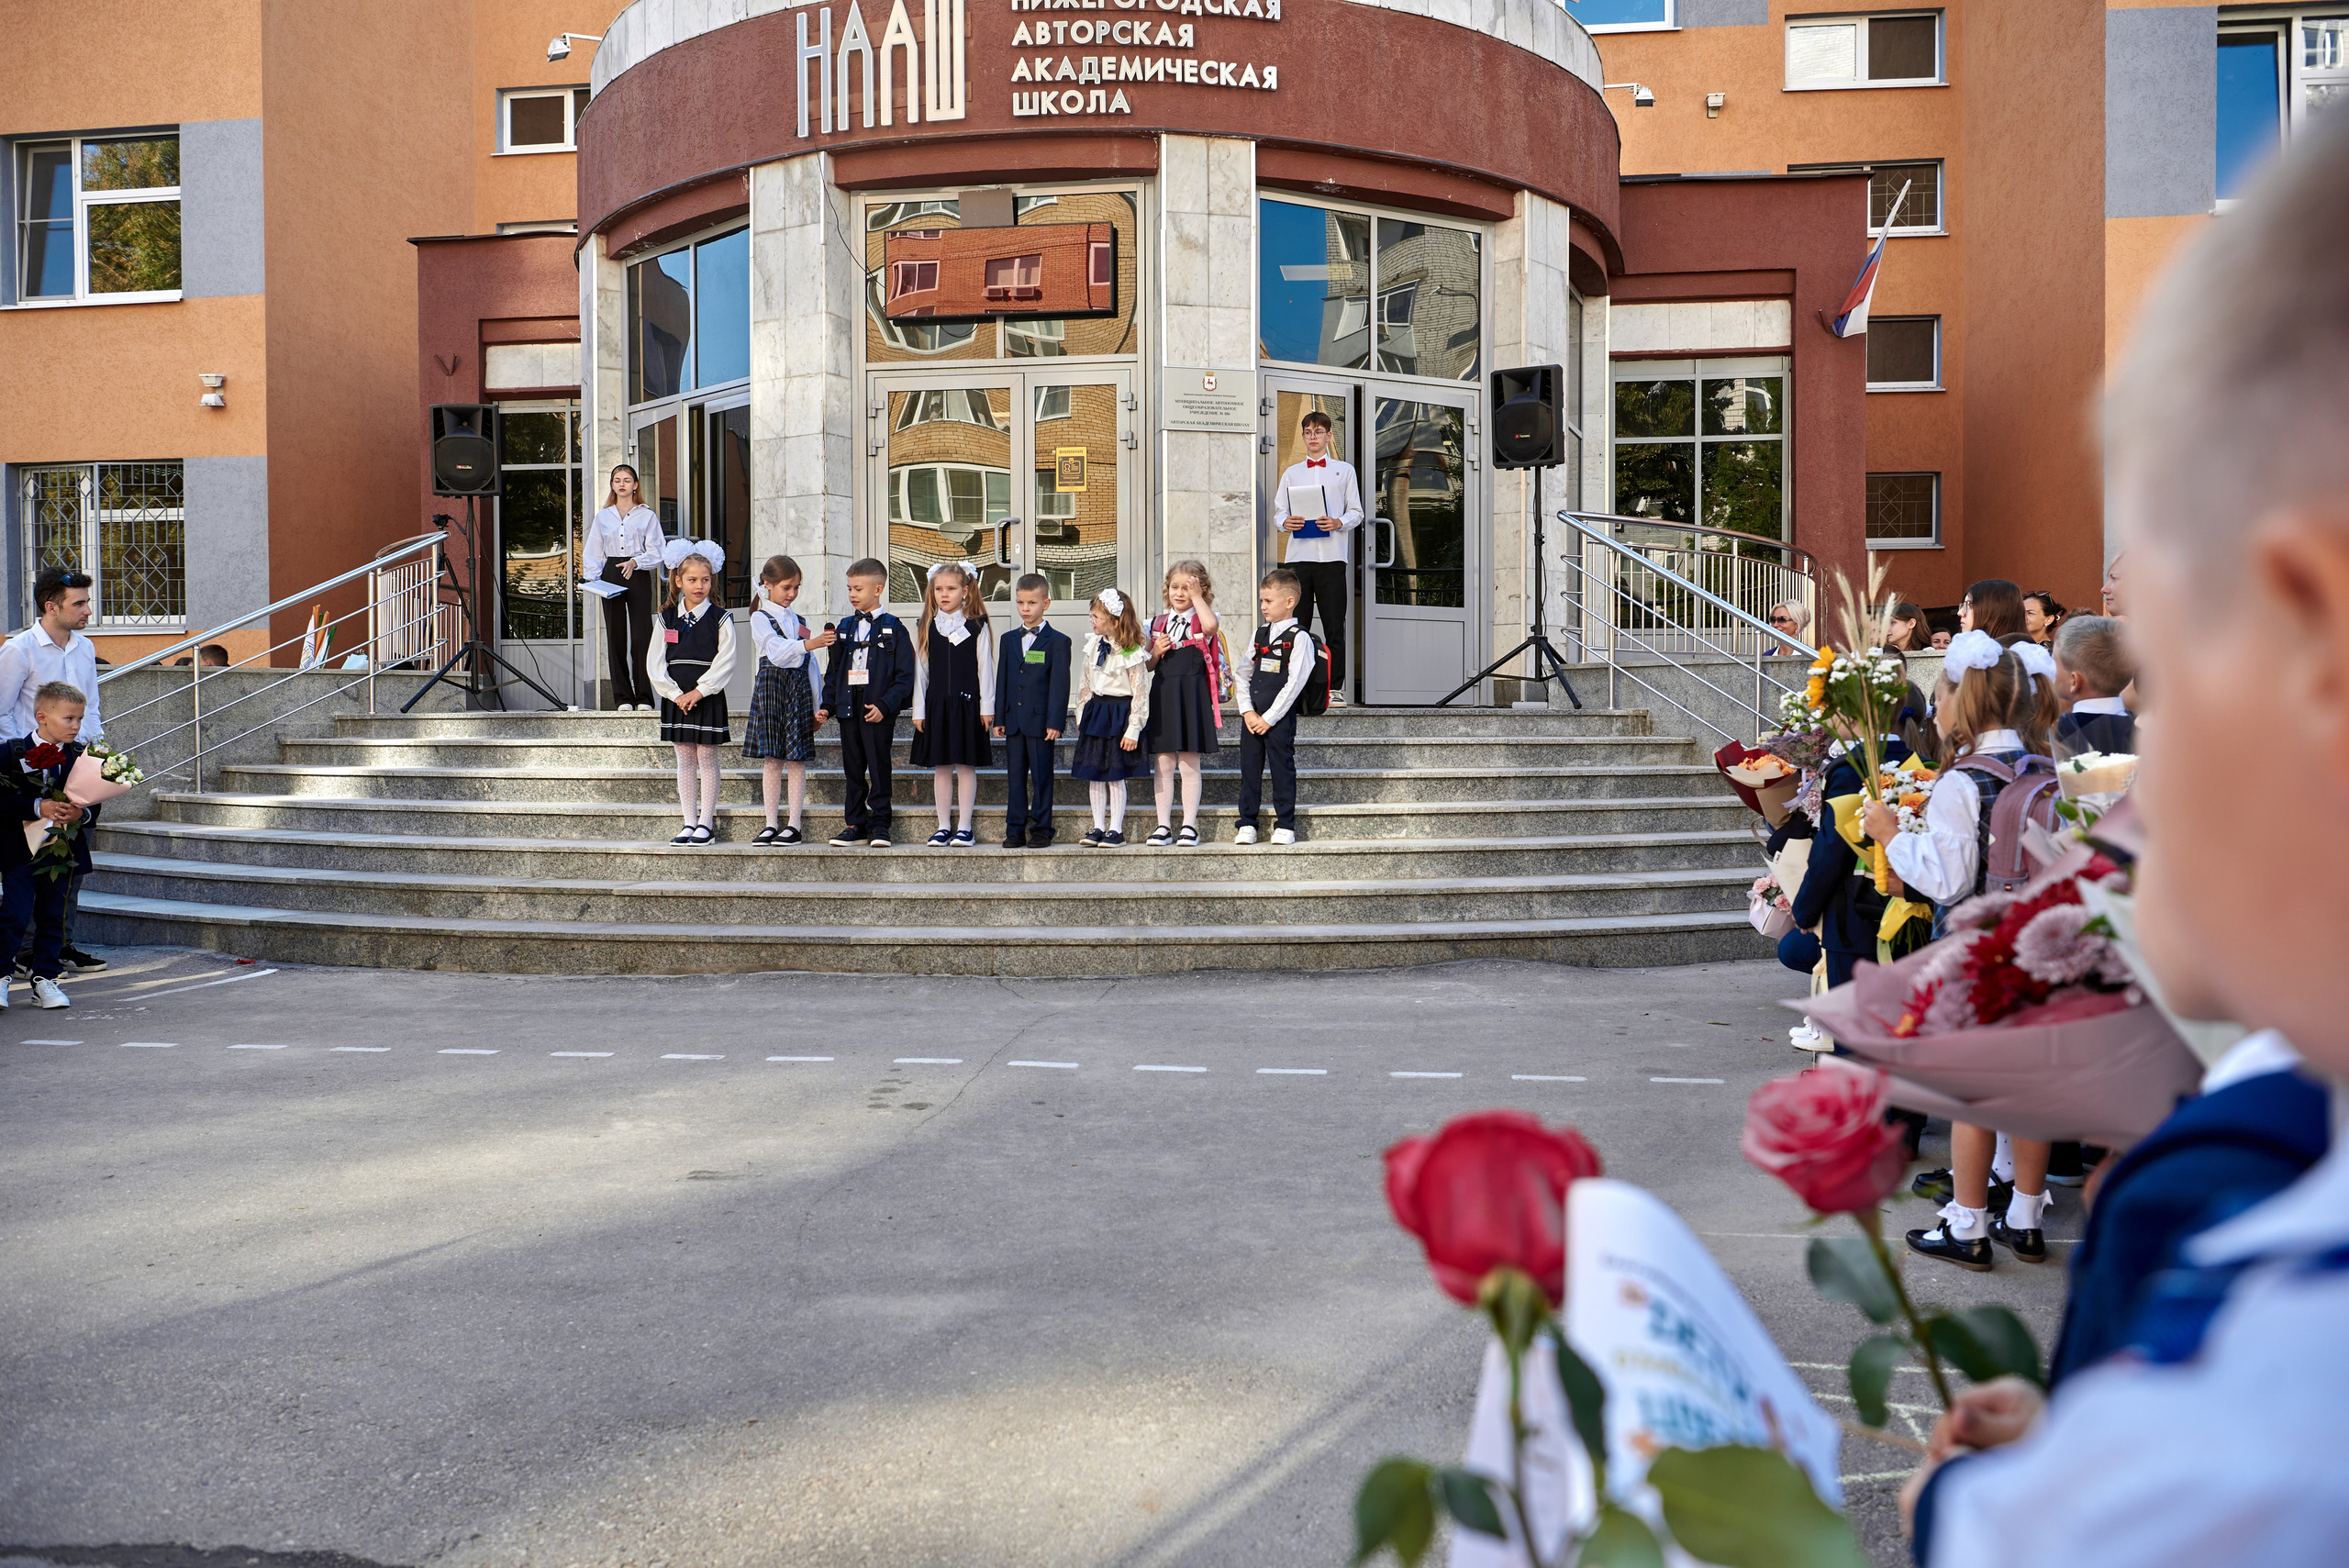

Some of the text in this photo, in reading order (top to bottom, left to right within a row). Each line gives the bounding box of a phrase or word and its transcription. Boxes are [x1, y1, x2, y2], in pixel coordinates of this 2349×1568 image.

[1011, 20, 1194, 48] АВТОРСКАЯ
[797, 0, 965, 138] НААШ
[1010, 55, 1278, 90] АКАДЕМИЧЕСКАЯ
[1012, 88, 1131, 116] ШКОЛА
